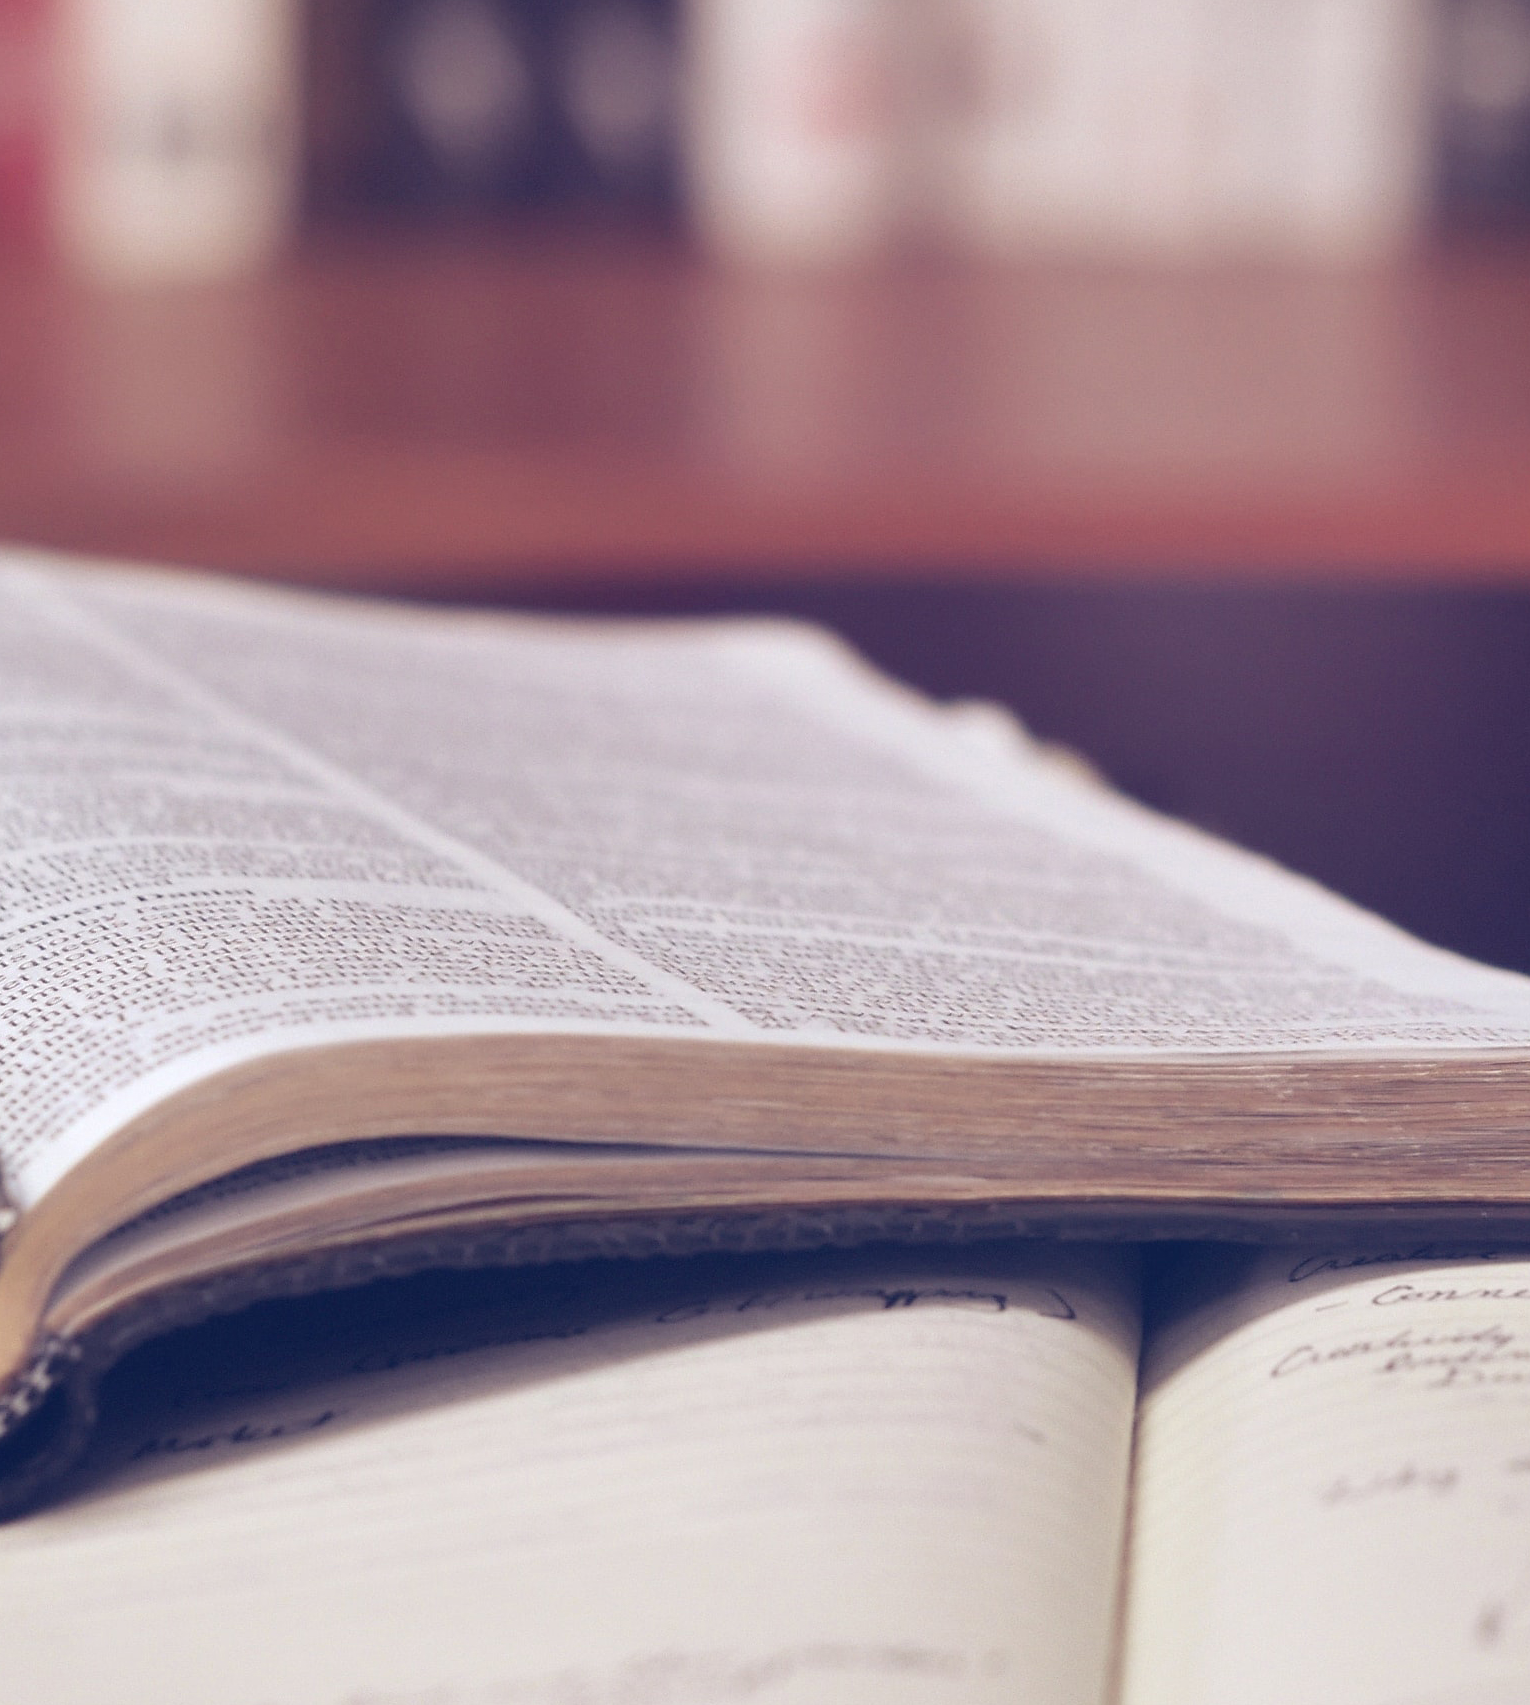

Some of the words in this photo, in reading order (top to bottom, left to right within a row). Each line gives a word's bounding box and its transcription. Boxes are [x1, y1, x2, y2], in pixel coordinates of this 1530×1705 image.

[18, 932, 124, 970] queen
[135, 913, 240, 931] spake
[34, 920, 129, 950] lords
[42, 947, 95, 971] not
[109, 932, 162, 947] thy
[186, 931, 229, 940] be
[0, 1005, 18, 1017] a
[28, 970, 102, 1001] man
[110, 956, 146, 967] in
[154, 943, 208, 955] thy
[8, 1000, 63, 1028] the
[70, 965, 149, 994] holy
[85, 974, 152, 999] and
